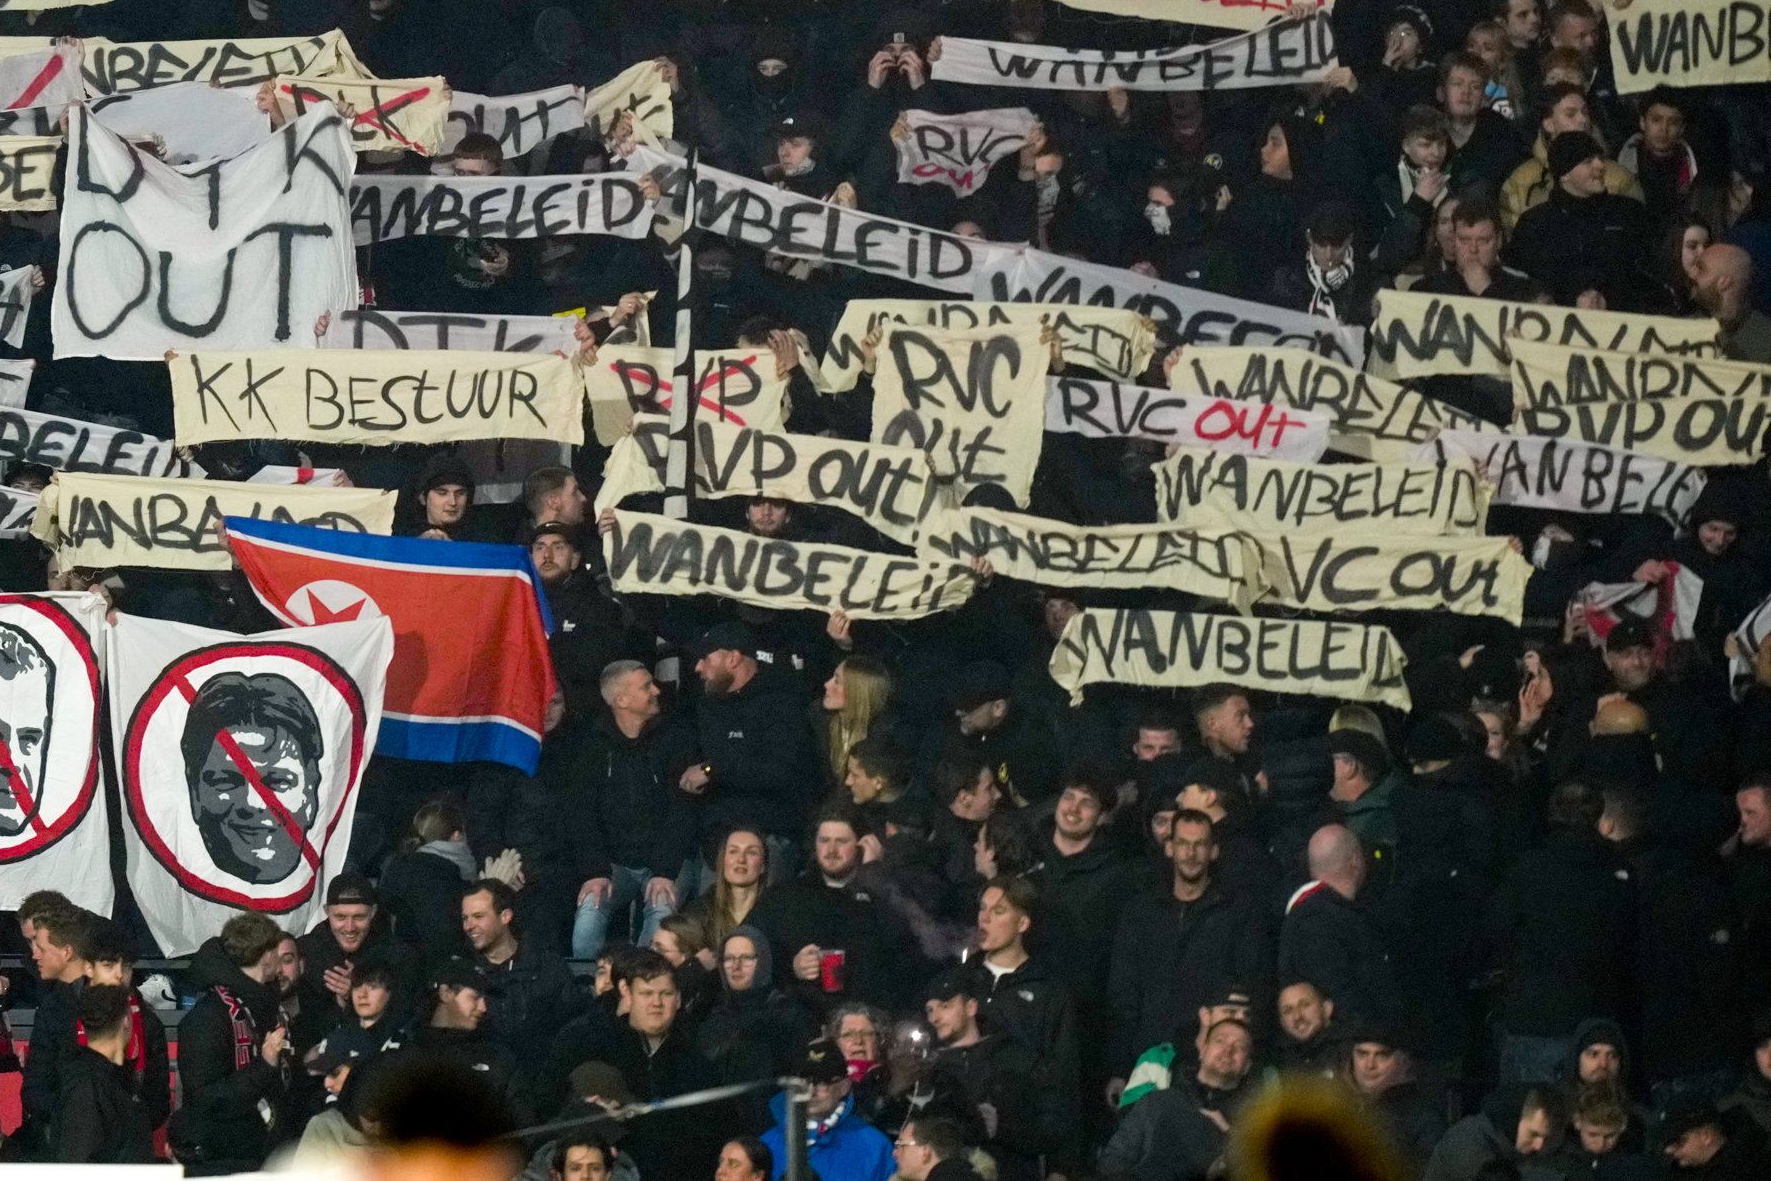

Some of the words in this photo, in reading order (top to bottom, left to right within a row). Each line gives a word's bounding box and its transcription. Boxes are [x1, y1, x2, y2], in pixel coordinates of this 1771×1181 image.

[1617, 1, 1771, 75] WANB
[349, 176, 645, 240] ANBELEiD
[67, 220, 332, 342] OUT
[191, 354, 285, 433] KK
[1057, 379, 1188, 436] RVC
